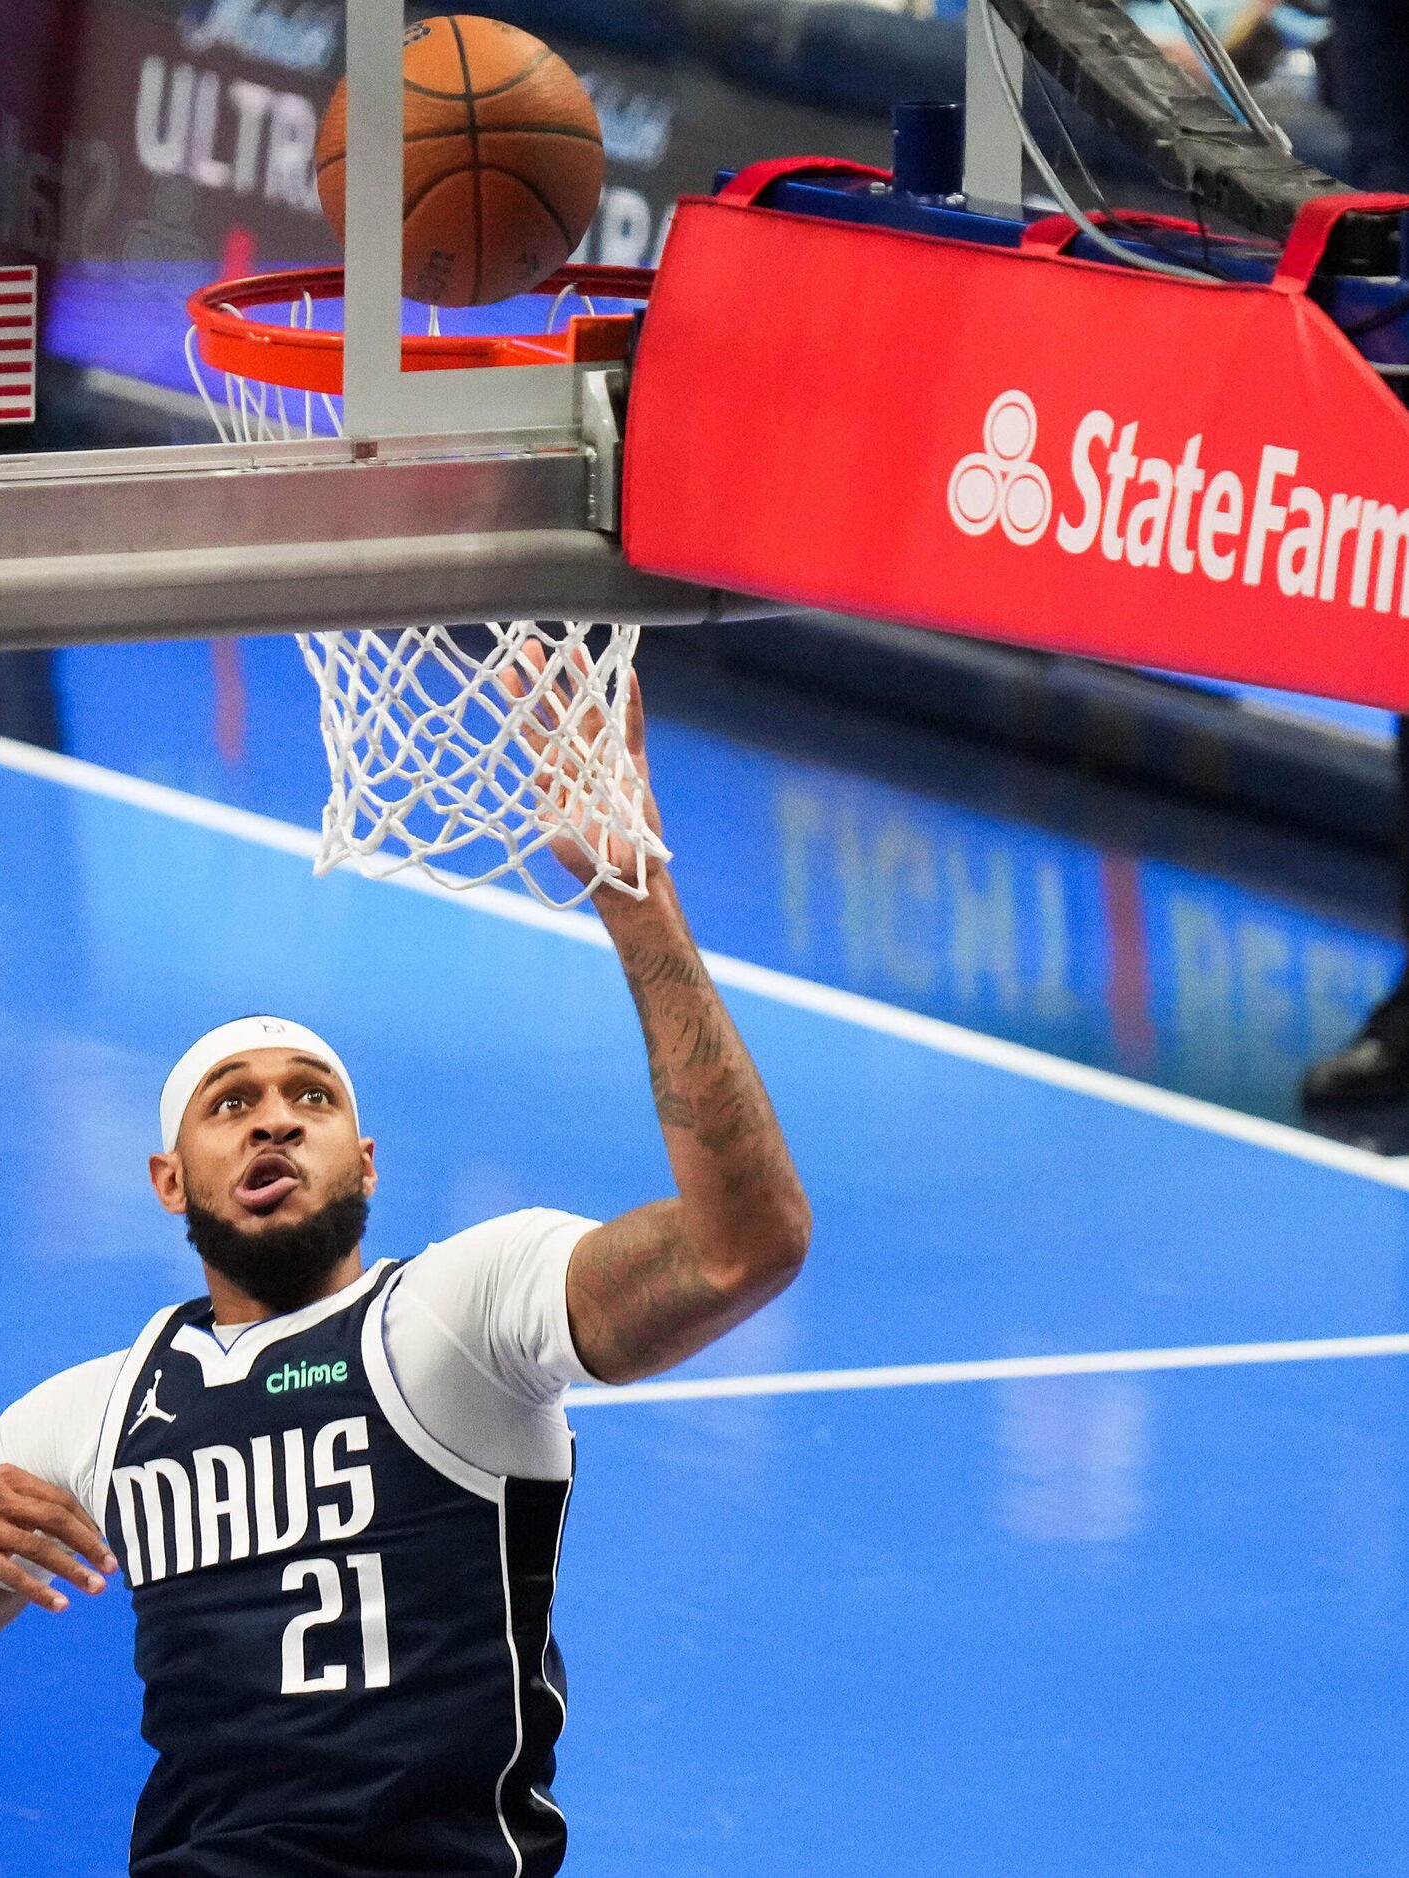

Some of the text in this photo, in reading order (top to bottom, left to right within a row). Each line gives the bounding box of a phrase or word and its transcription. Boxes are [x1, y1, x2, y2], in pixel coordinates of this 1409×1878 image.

[134, 55, 323, 213] ULTR
[266, 1360, 348, 1394] chime
[113, 1416, 375, 1587] MAVS
[281, 1553, 391, 1695] 21
